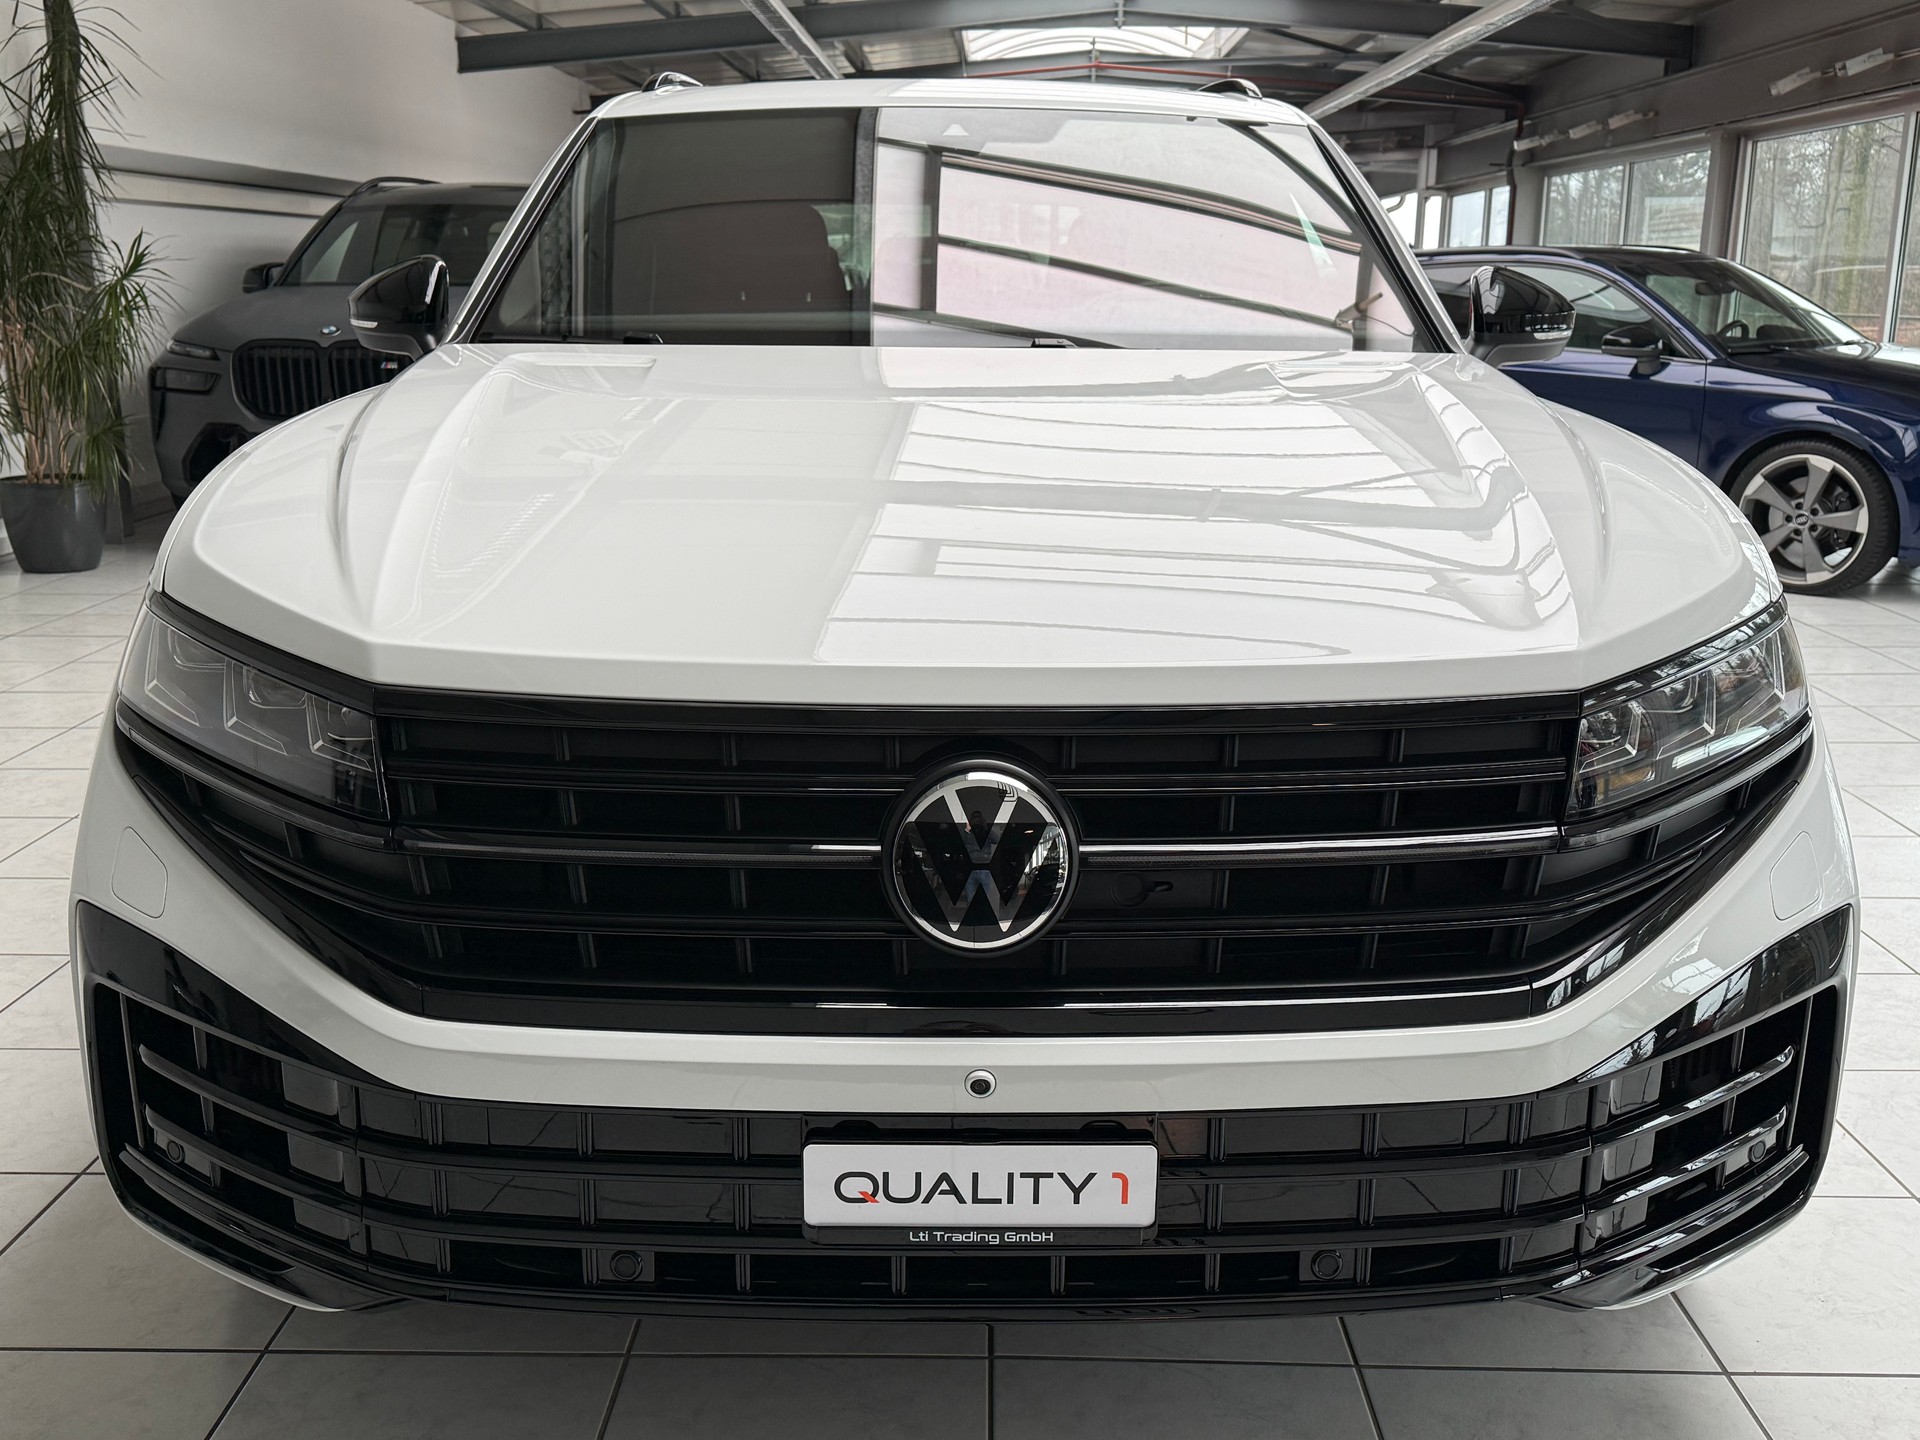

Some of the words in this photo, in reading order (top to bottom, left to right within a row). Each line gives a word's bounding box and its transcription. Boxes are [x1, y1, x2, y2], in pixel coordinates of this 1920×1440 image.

[833, 1171, 1098, 1205] QUALITY
[1111, 1172, 1129, 1205] 1
[909, 1231, 929, 1242] Lti
[933, 1231, 1000, 1245] Trading
[1004, 1231, 1054, 1242] GmbH
